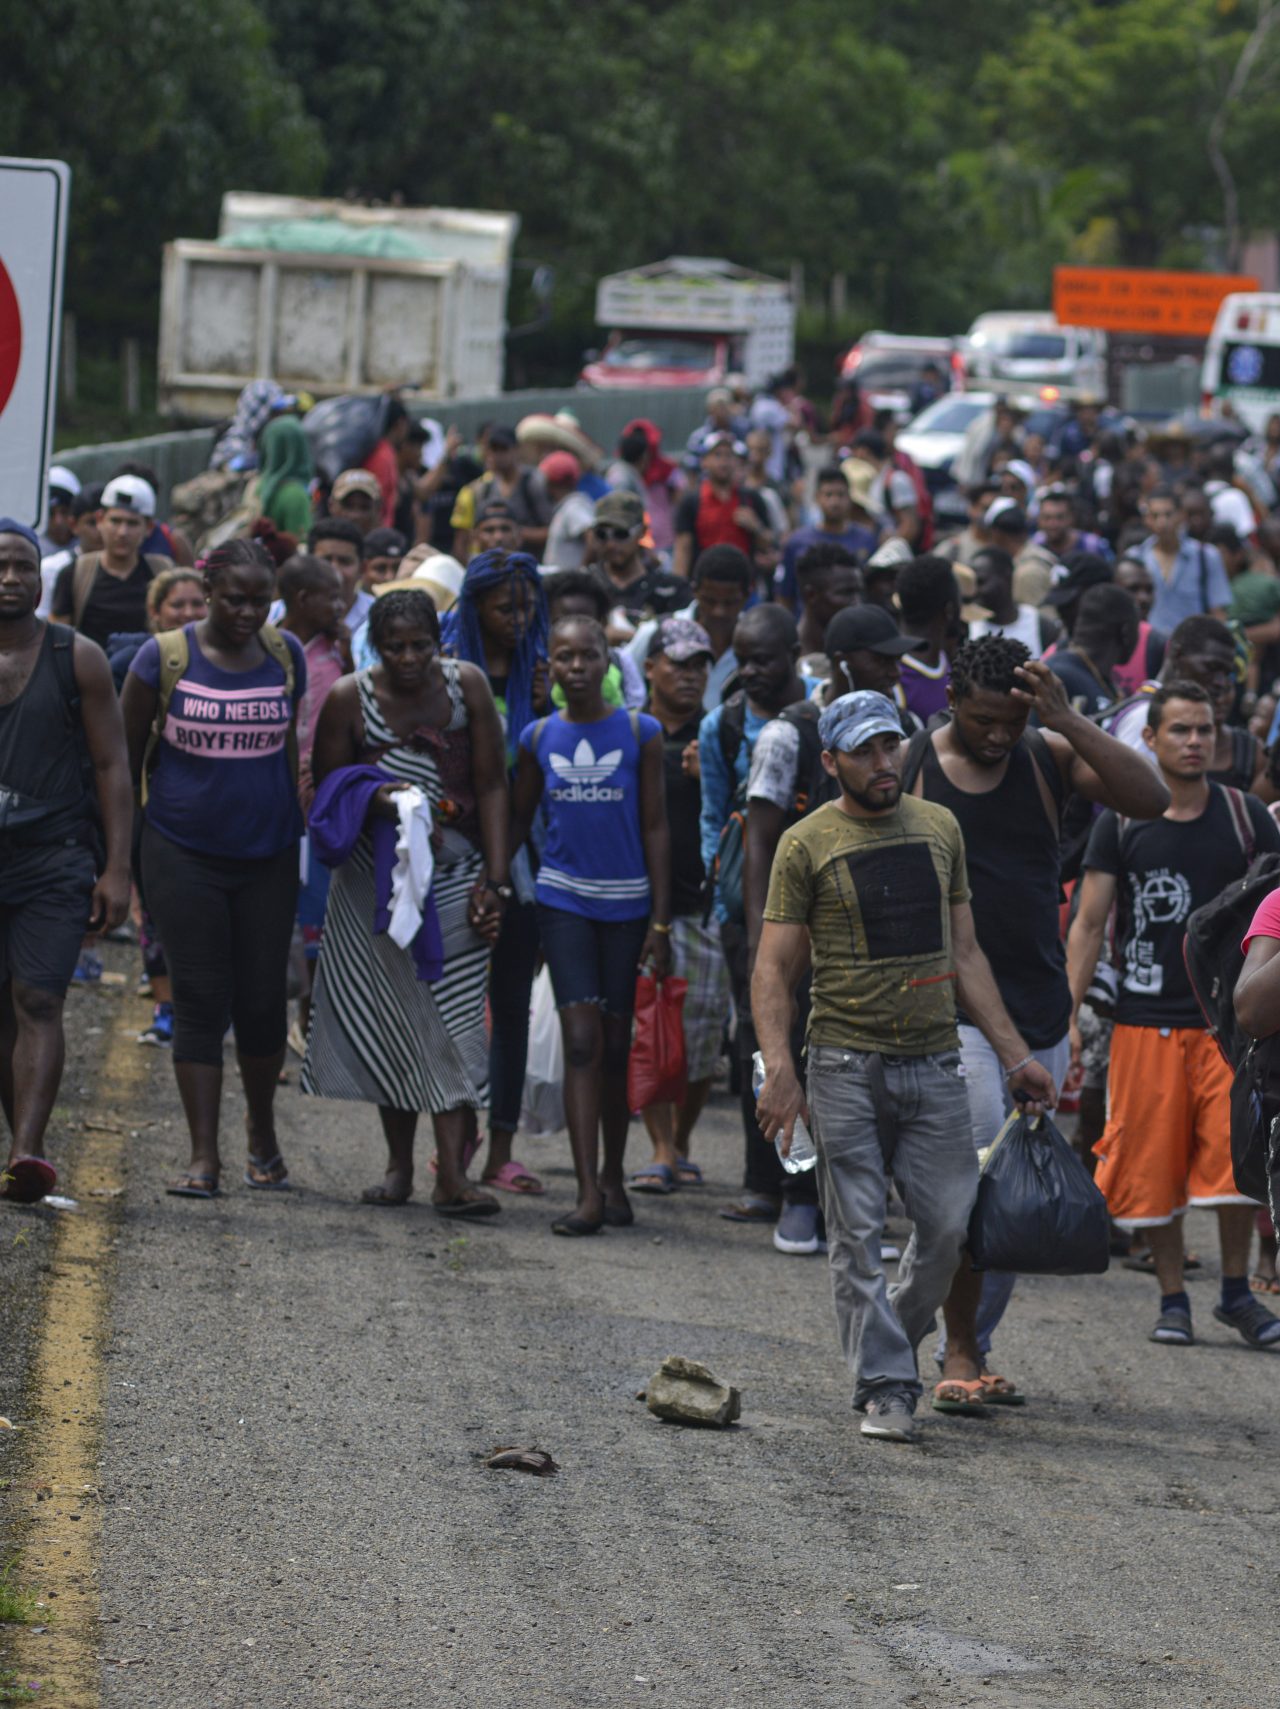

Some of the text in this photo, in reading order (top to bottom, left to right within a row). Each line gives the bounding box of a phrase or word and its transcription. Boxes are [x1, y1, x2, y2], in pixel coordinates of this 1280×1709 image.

[183, 697, 220, 719] WHO
[225, 701, 280, 720] NEEDS
[176, 726, 287, 751] BOYFRIEN
[549, 785, 624, 802] adidas
